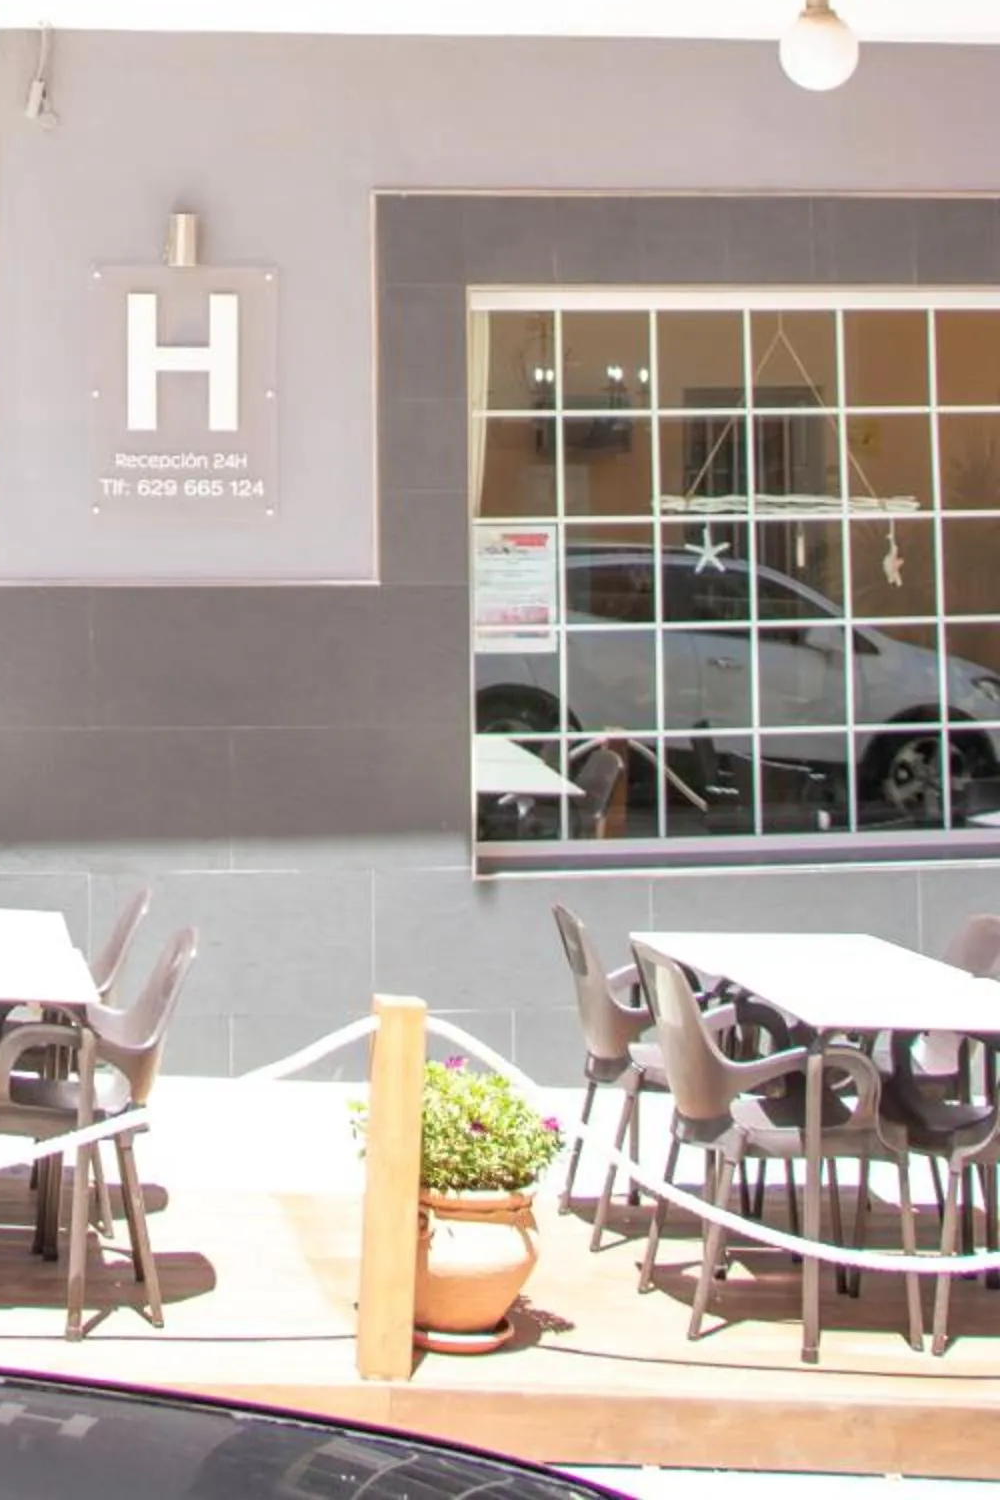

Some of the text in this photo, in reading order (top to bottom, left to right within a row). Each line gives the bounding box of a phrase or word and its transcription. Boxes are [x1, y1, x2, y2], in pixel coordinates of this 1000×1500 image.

[126, 292, 239, 432] H
[213, 452, 248, 470] 24H
[137, 479, 178, 497] 629
[183, 479, 224, 497] 665
[229, 479, 265, 497] 124
